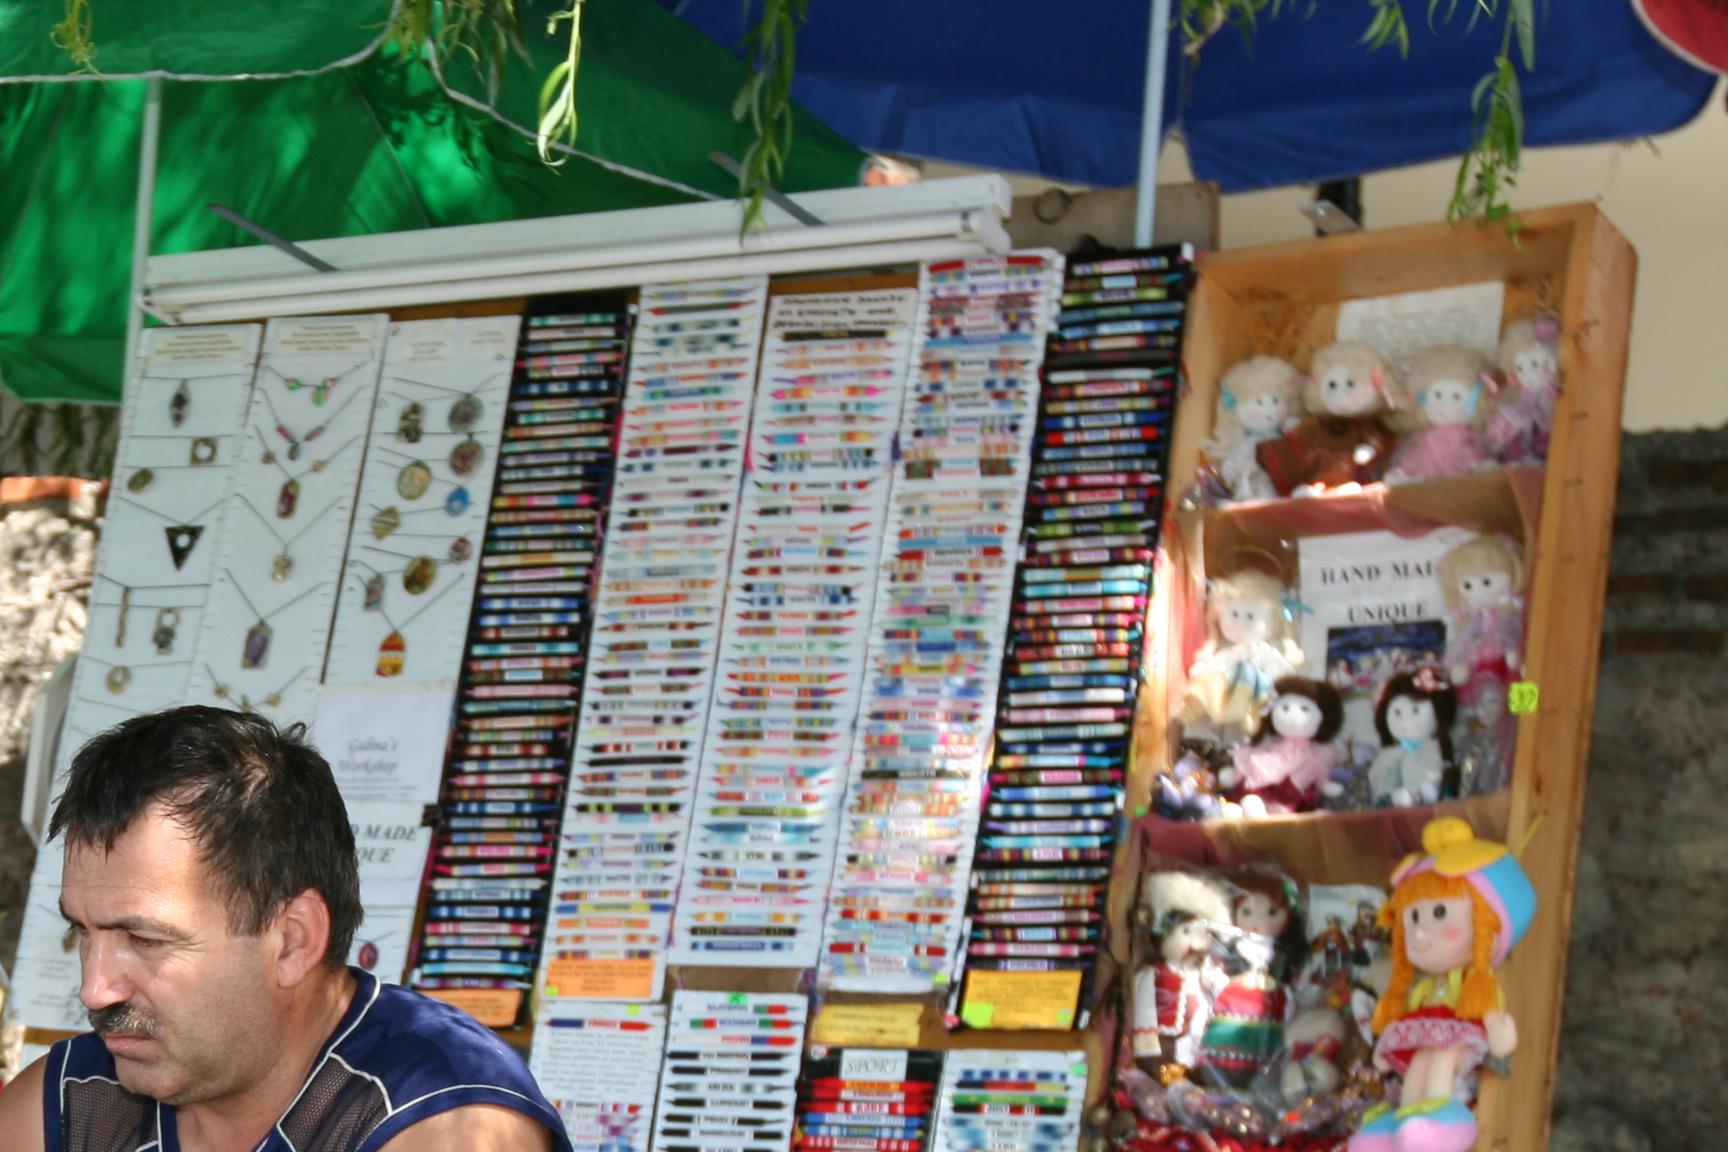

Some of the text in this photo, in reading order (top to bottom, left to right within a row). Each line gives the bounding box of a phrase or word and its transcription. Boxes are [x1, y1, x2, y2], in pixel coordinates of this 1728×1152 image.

[1320, 560, 1435, 586] HAND MA
[1347, 600, 1429, 625] UNIQUE
[337, 758, 399, 775] Workshop
[363, 823, 418, 841] MADE
[845, 1058, 899, 1073] SPORT
